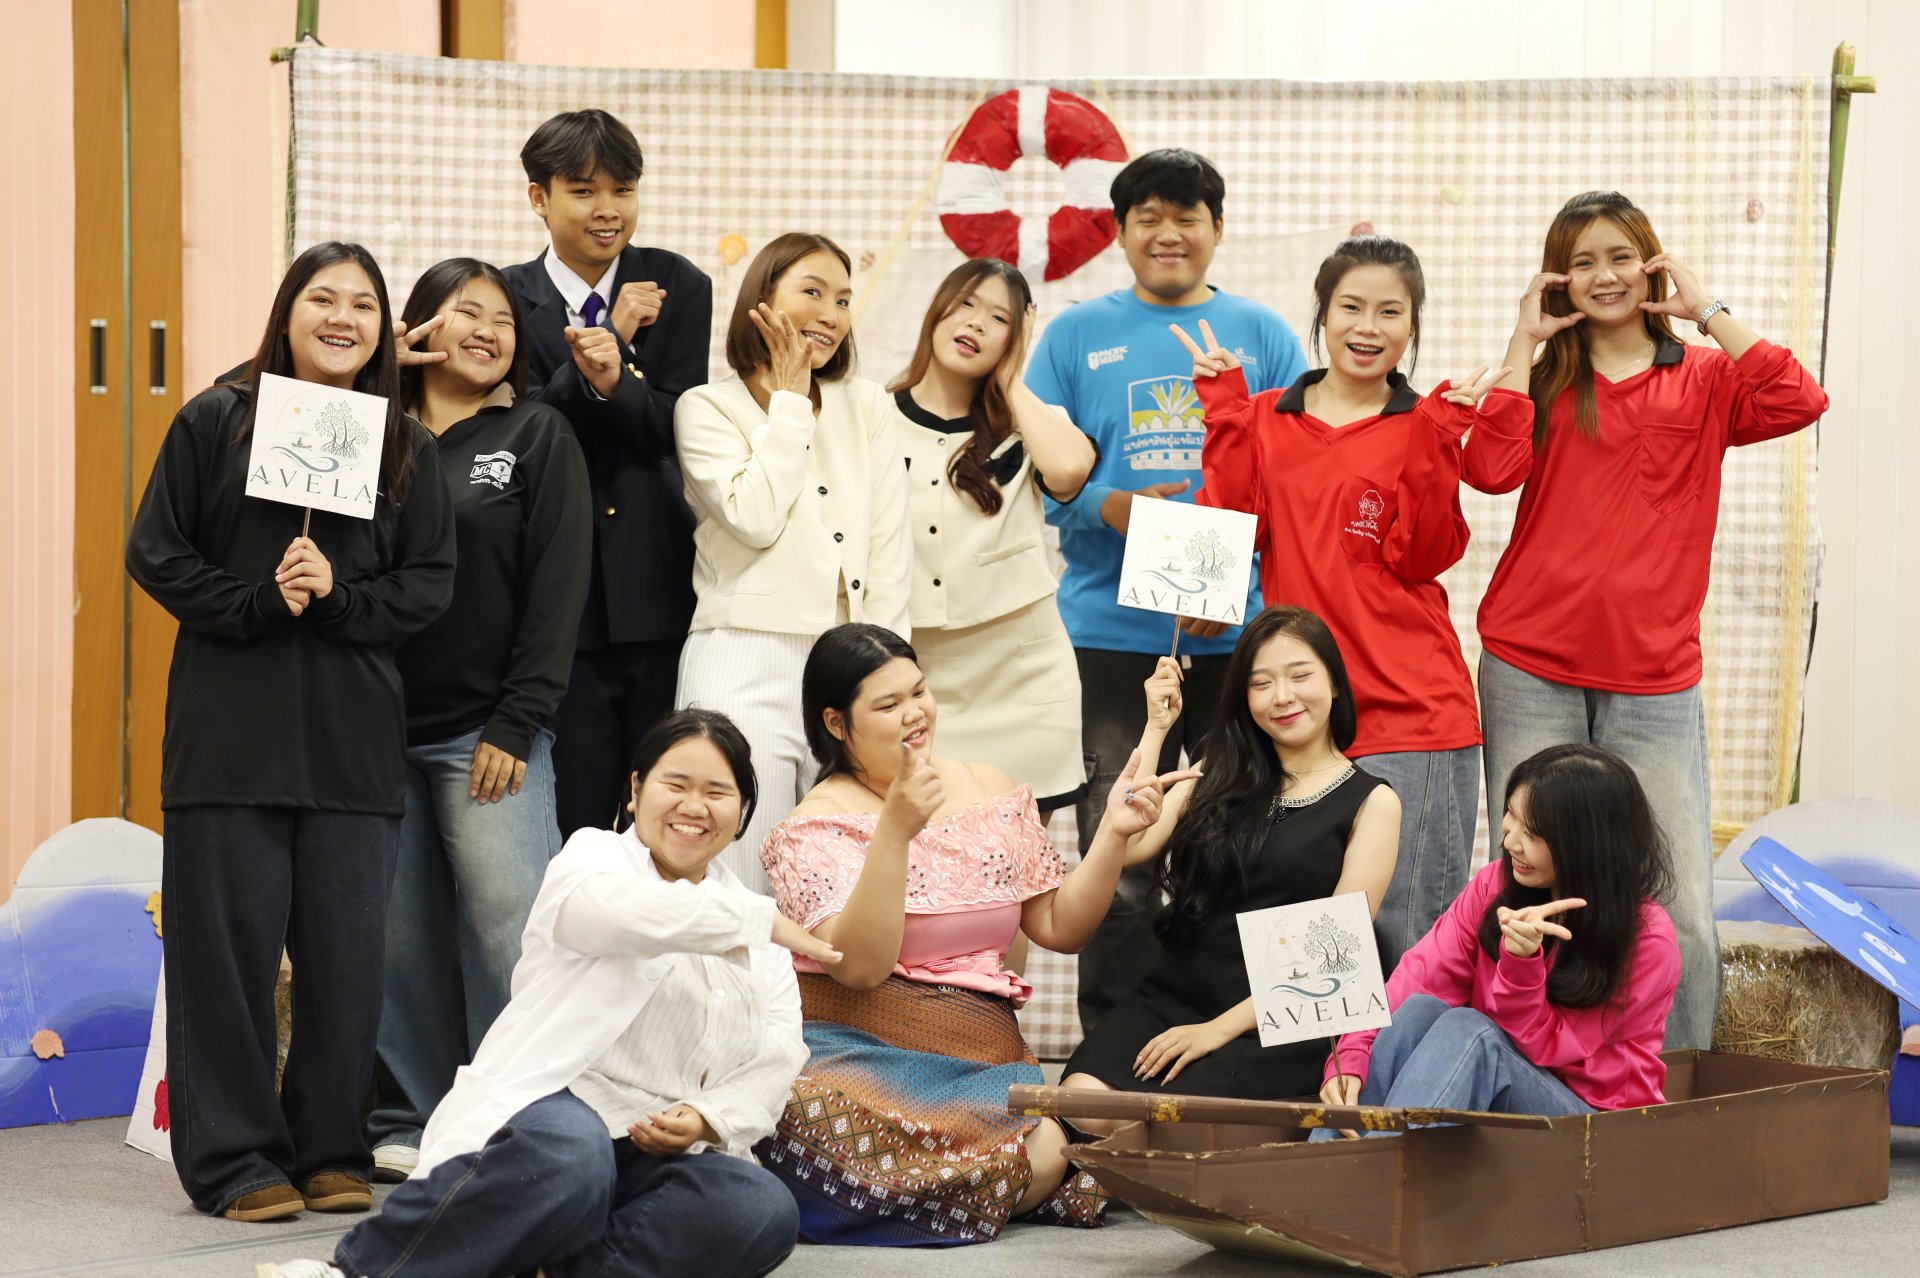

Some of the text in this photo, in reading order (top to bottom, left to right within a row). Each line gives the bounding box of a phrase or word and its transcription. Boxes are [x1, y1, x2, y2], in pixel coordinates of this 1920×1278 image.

[250, 464, 373, 504] AVELA
[1122, 587, 1239, 622] AVELA
[1261, 992, 1386, 1032] AVELA
